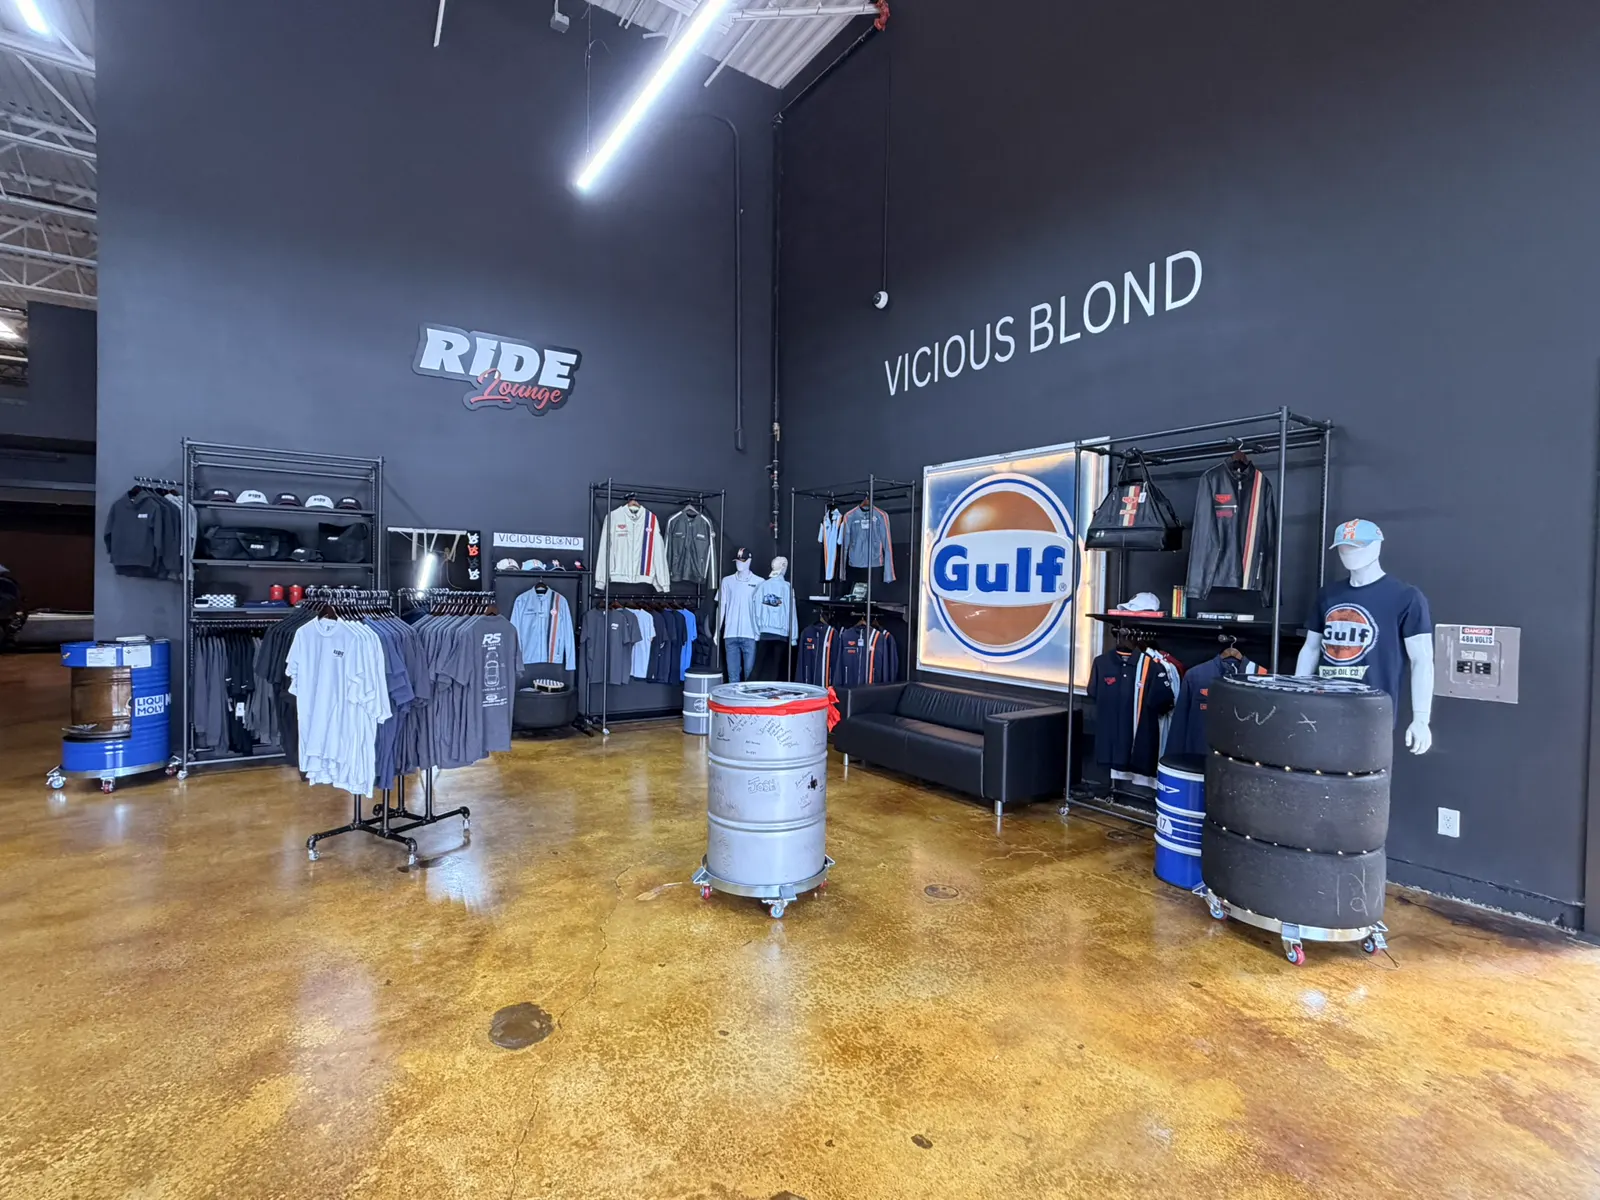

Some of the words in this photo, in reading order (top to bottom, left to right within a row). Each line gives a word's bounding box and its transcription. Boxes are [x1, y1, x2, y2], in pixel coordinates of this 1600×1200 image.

[884, 315, 1016, 396] VICIOUS
[1029, 250, 1203, 353] BLOND
[419, 328, 578, 389] RIDE
[470, 368, 563, 409] Lounge
[498, 533, 543, 545] VICIOUS
[934, 544, 1066, 593] Gulf
[1322, 624, 1370, 643] Gulf
[1463, 627, 1492, 635] DANGER
[482, 633, 501, 645] RS
[1461, 635, 1474, 643] 480
[1475, 636, 1493, 645] VOLTS
[1338, 668, 1348, 676] OIL
[136, 695, 164, 707] LIQUI
[136, 704, 164, 716] MOLY
